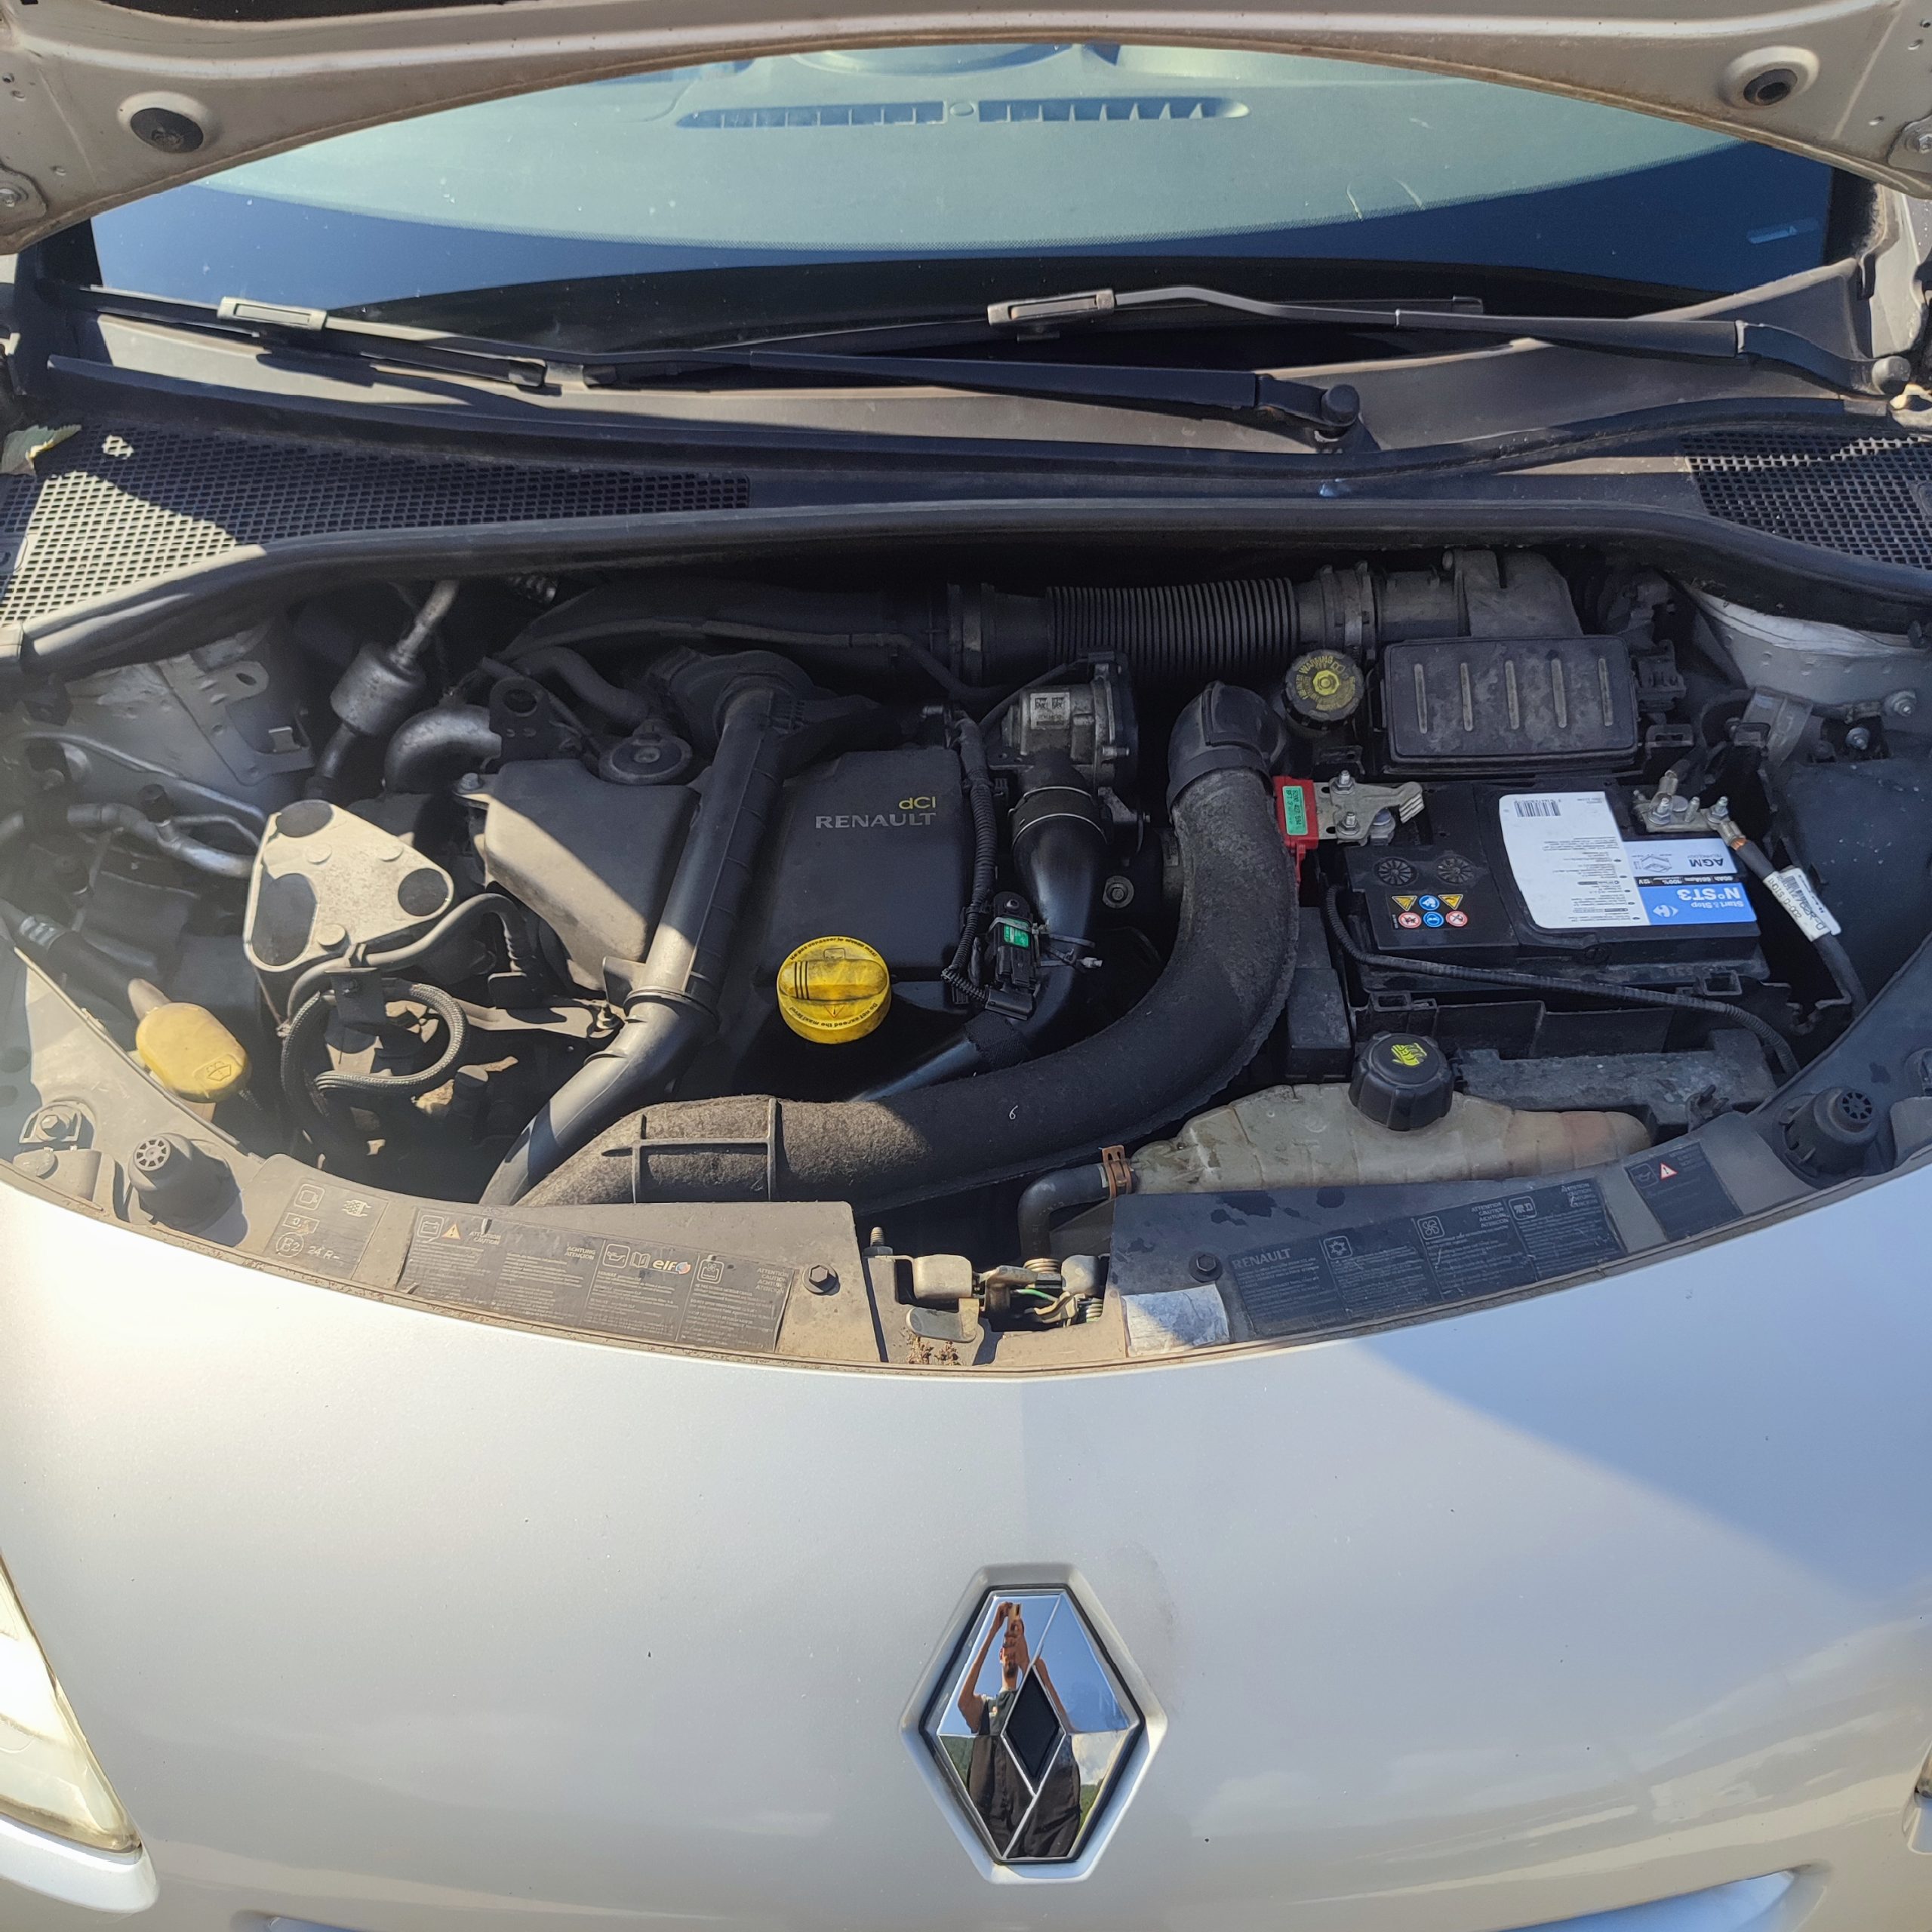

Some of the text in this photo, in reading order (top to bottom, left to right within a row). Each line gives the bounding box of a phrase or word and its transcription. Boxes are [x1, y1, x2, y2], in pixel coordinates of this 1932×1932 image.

[1299, 655, 1334, 674] WARNING
[815, 813, 937, 829] RENAULT
[1689, 858, 1724, 868] AGM
[869, 1002, 878, 1012] Do
[567, 1246, 596, 1255] ACHTUNG
[1232, 1248, 1291, 1269] RENAULT
[652, 1260, 678, 1271] elf
[757, 1279, 786, 1287] ACHTUN
